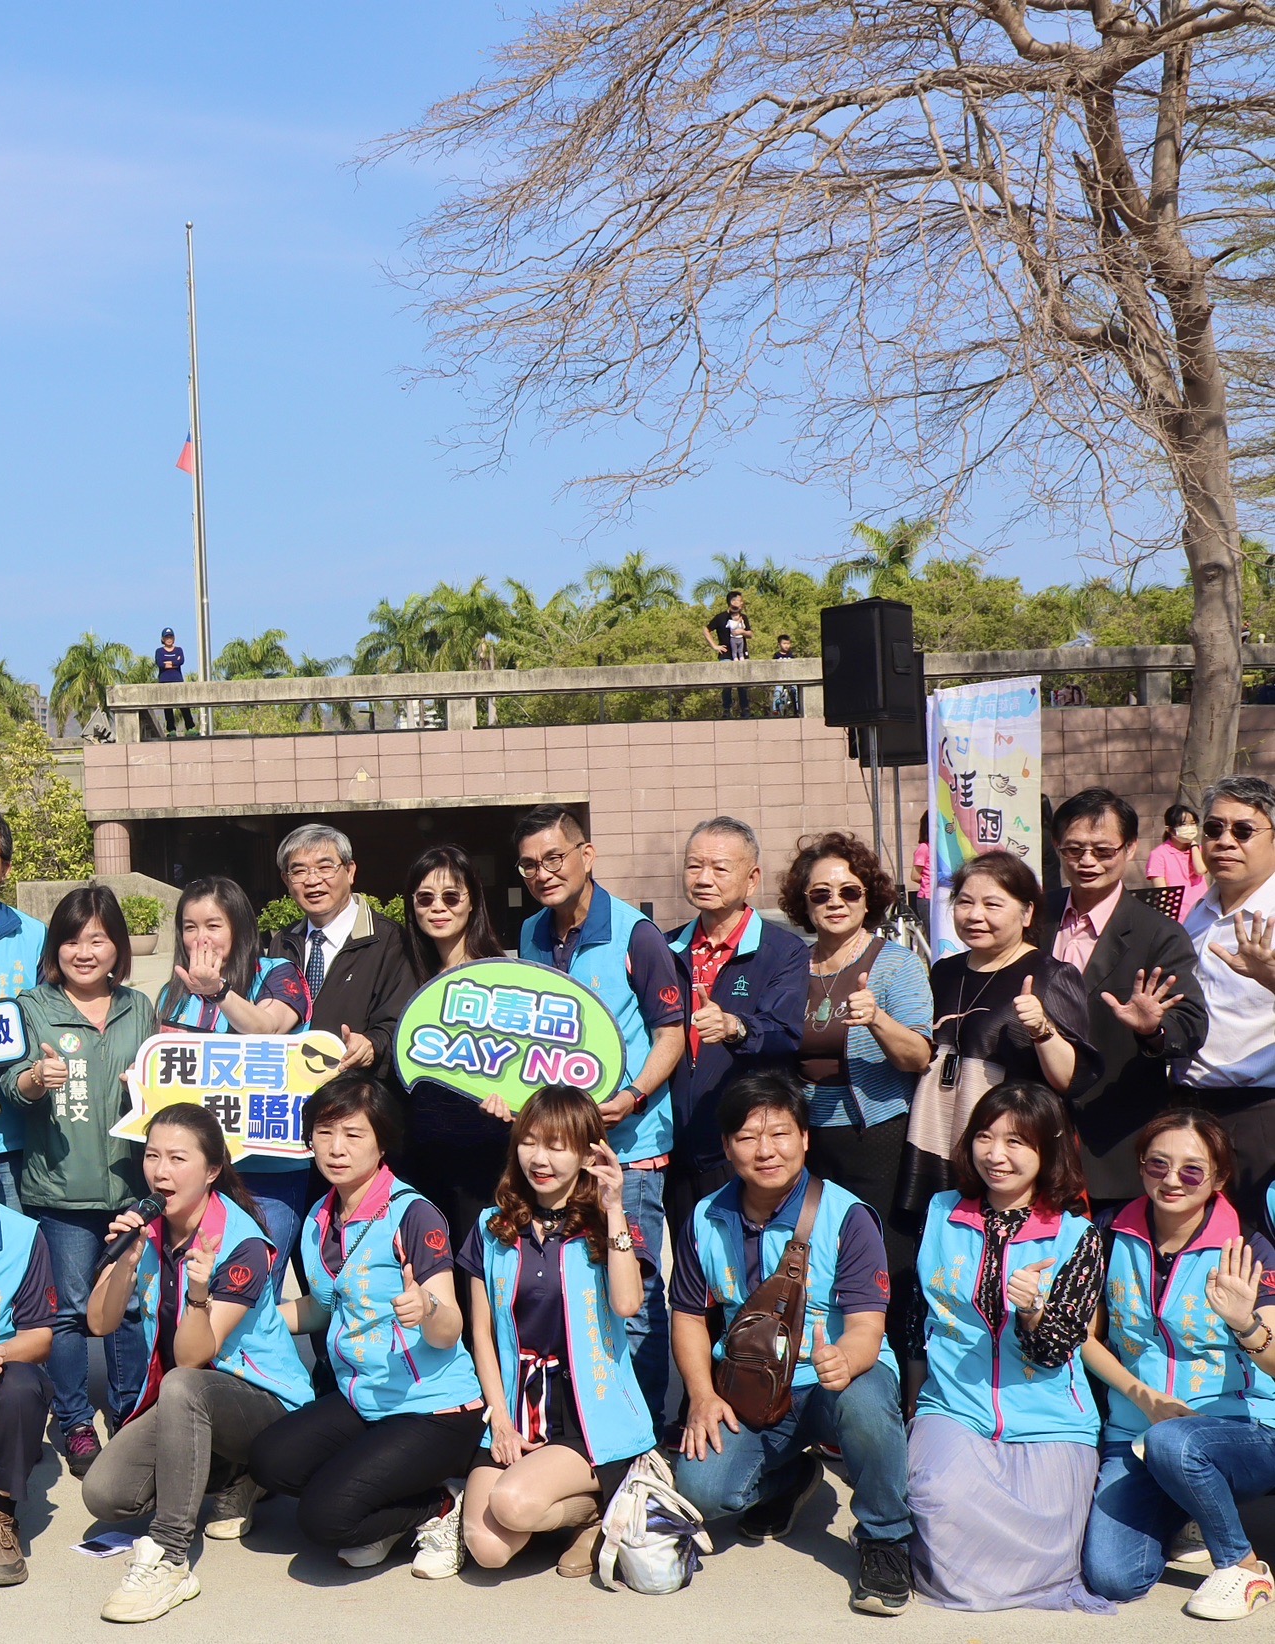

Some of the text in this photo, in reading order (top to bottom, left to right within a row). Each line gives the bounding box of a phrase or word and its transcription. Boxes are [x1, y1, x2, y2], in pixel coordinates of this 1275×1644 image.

[446, 985, 575, 1039] 向毒品
[159, 1041, 285, 1089] 我反毒
[414, 1031, 596, 1085] SAY NO
[68, 1059, 90, 1123] 陳慧文
[582, 1288, 608, 1400] 家長會長協會
